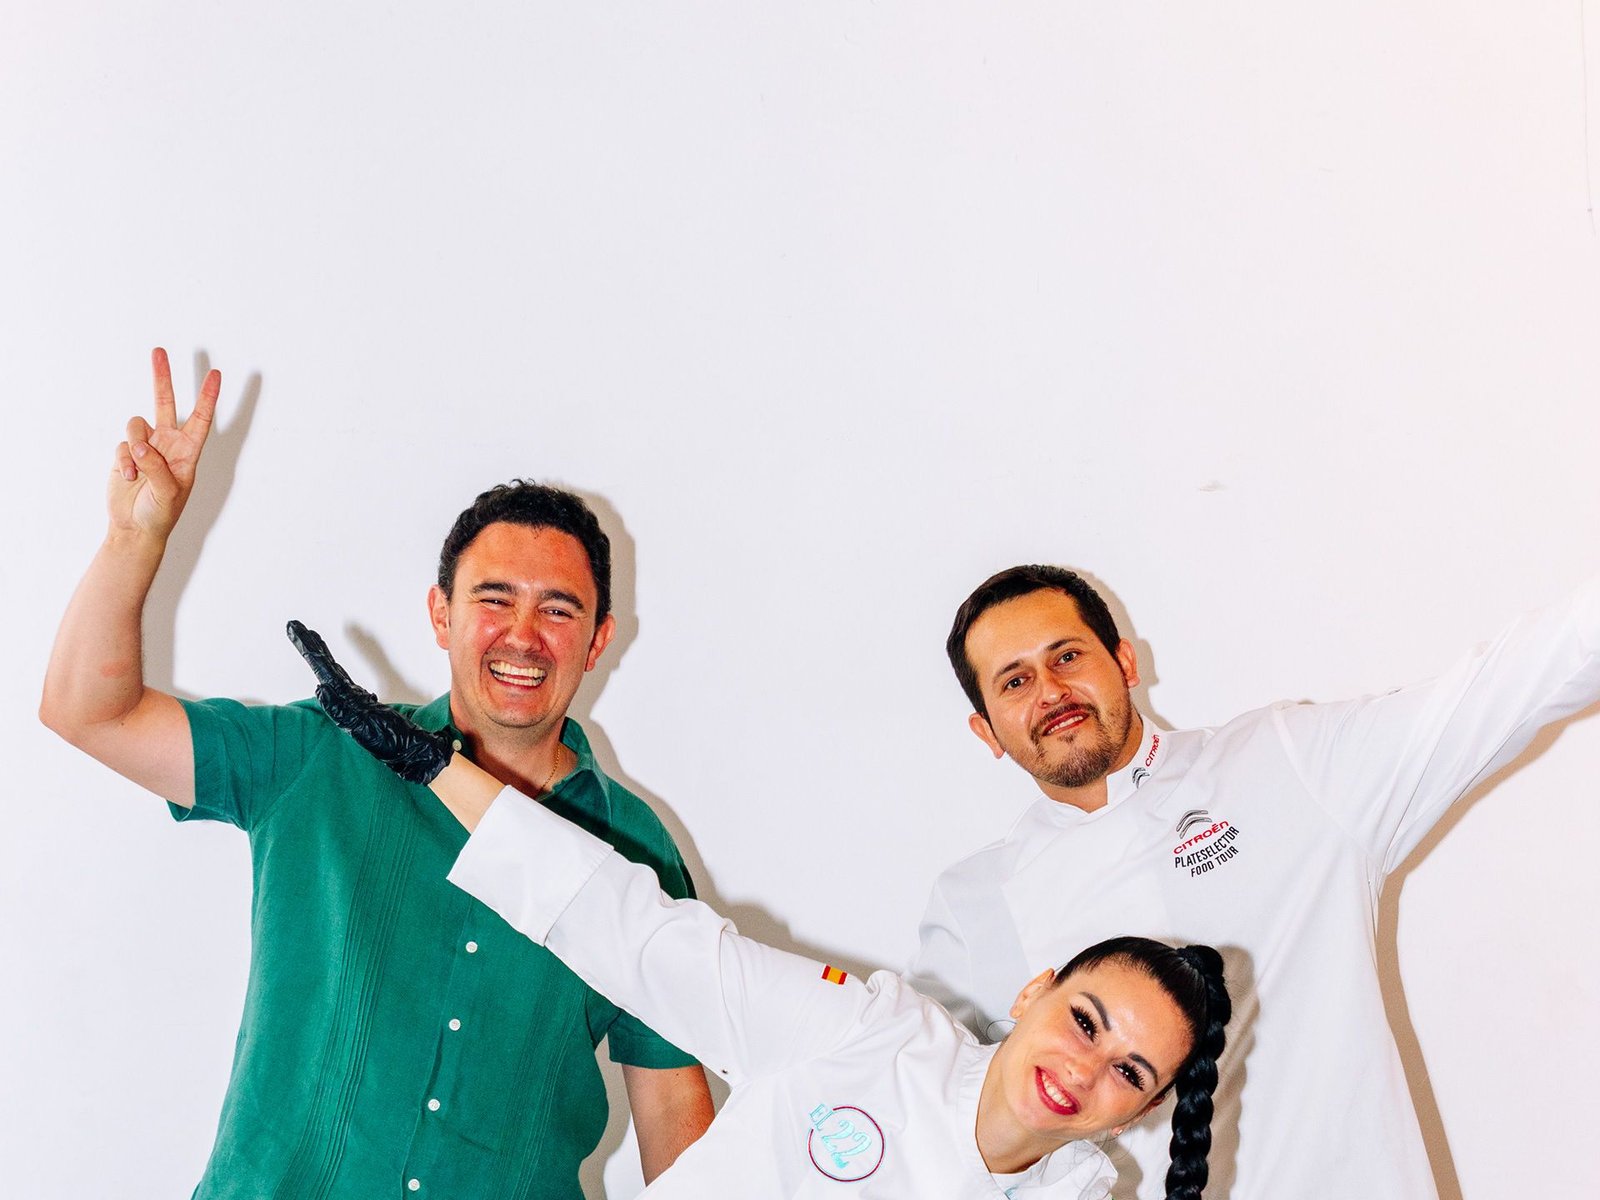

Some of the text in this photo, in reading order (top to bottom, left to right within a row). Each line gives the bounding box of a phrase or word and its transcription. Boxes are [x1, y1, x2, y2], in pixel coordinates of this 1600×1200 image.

[1174, 826, 1240, 869] PLATESELECTOR
[1190, 845, 1239, 878] FOOD TOUR
[821, 1119, 873, 1169] 22
